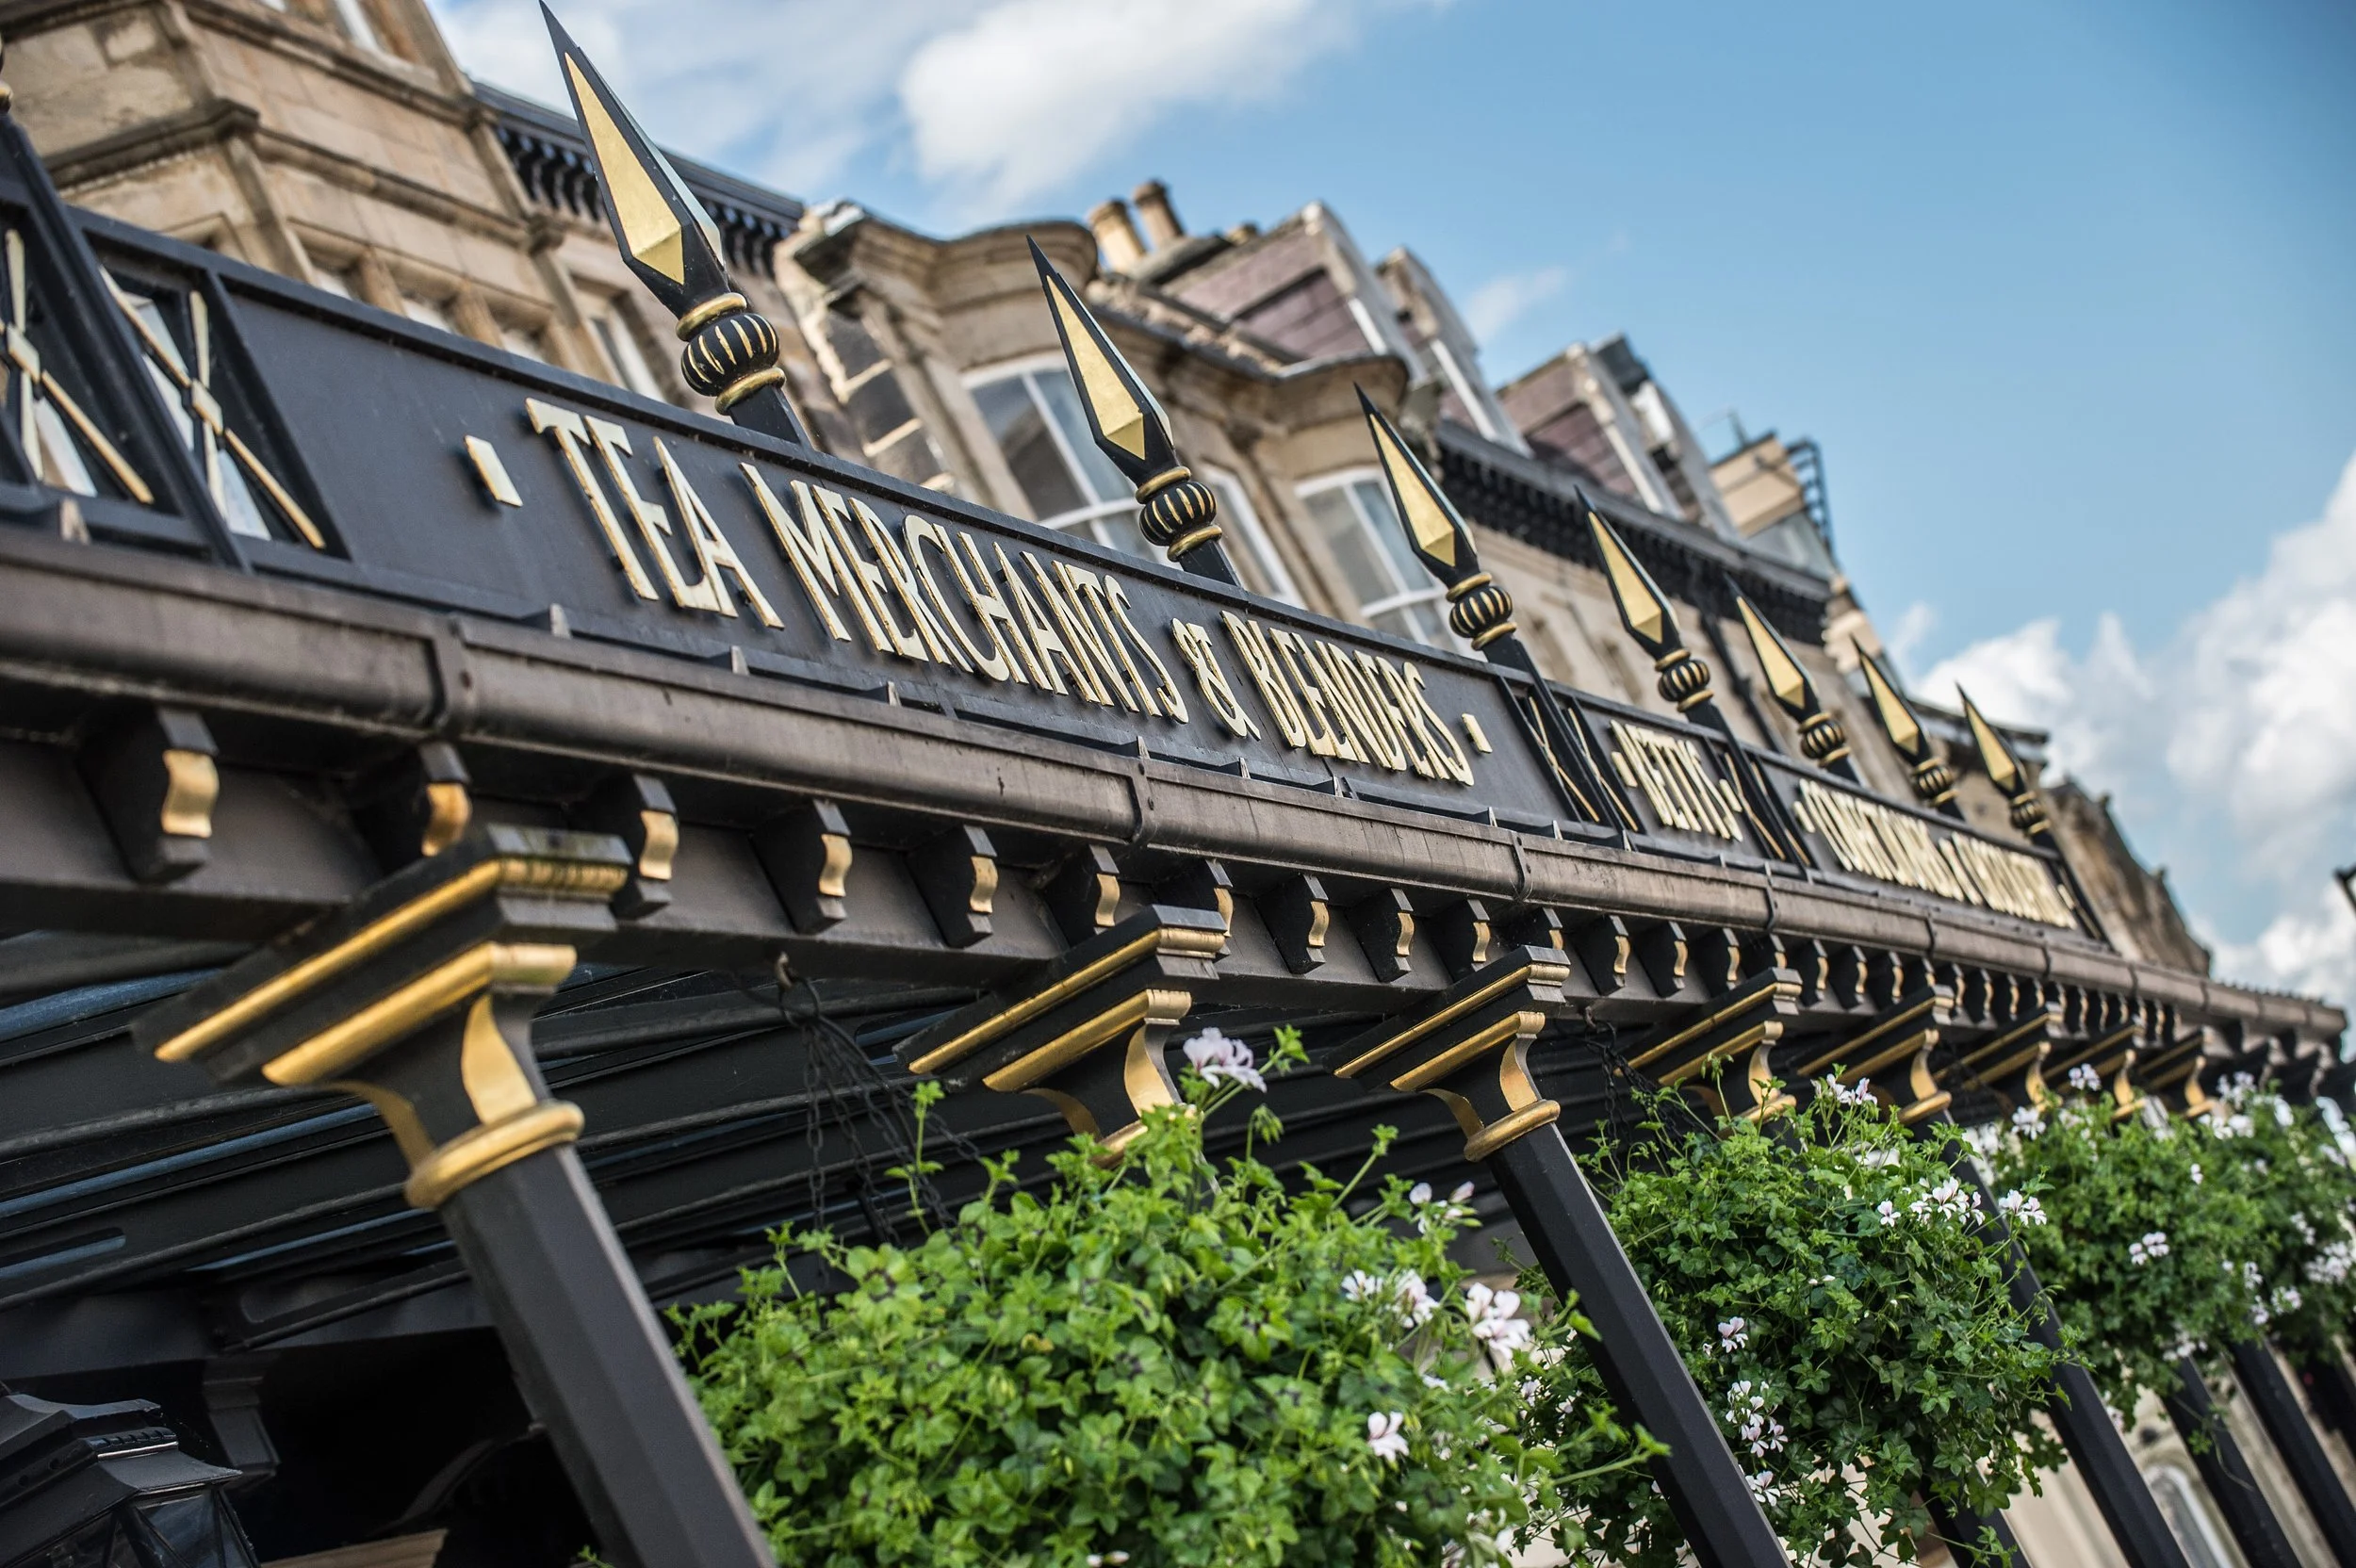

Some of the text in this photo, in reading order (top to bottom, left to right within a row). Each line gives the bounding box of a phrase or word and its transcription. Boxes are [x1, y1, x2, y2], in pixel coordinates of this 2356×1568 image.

[525, 397, 1474, 786] TEA MERCHANTS & BLENDERS
[1610, 719, 1742, 841] BETTYS
